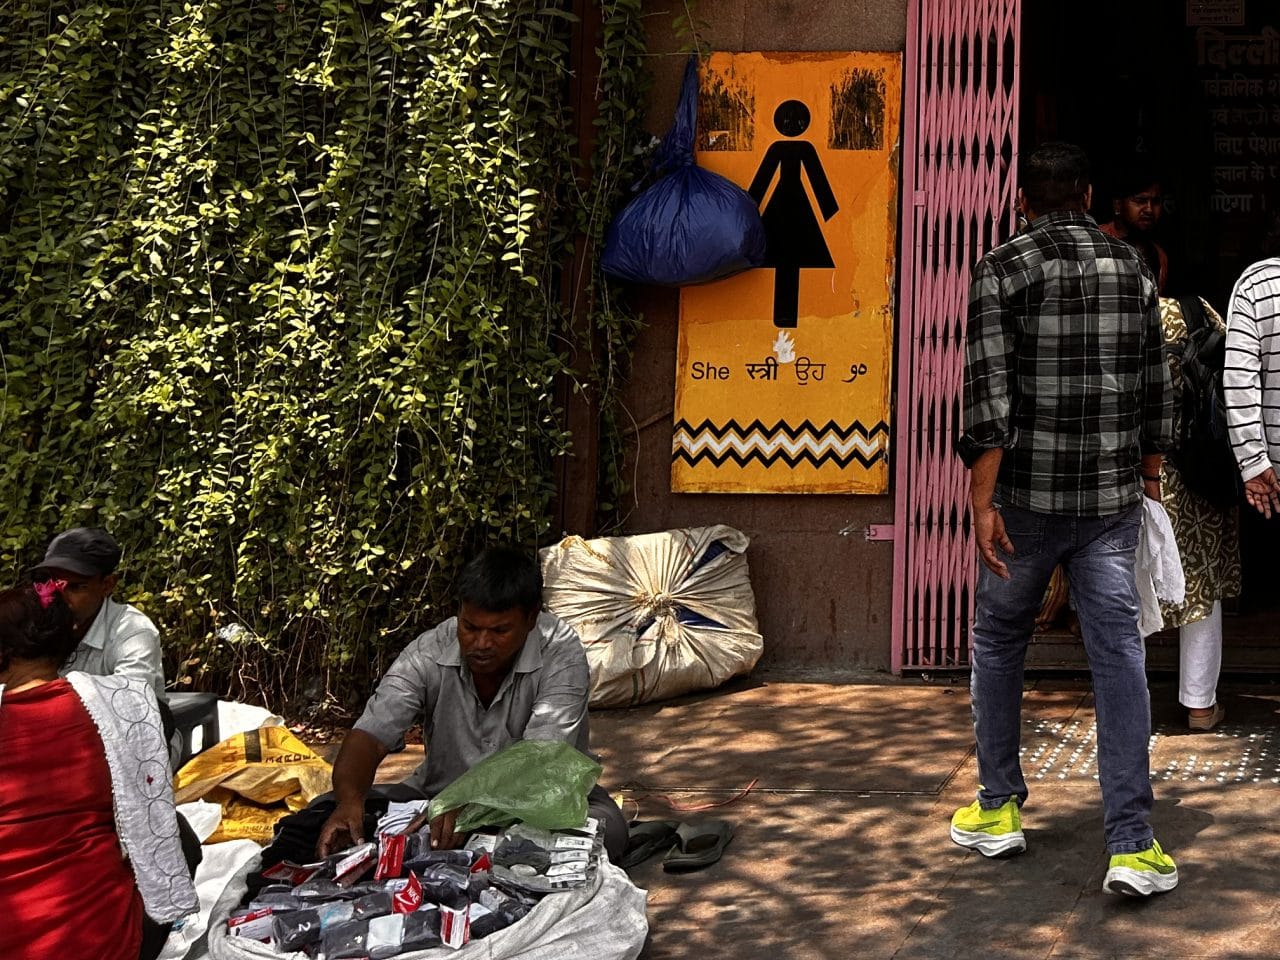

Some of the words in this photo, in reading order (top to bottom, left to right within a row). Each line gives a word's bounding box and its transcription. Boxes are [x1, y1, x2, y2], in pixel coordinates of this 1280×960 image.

[691, 361, 730, 380] She
[745, 356, 779, 381] स्त्री
[794, 356, 826, 386] ਉਹ
